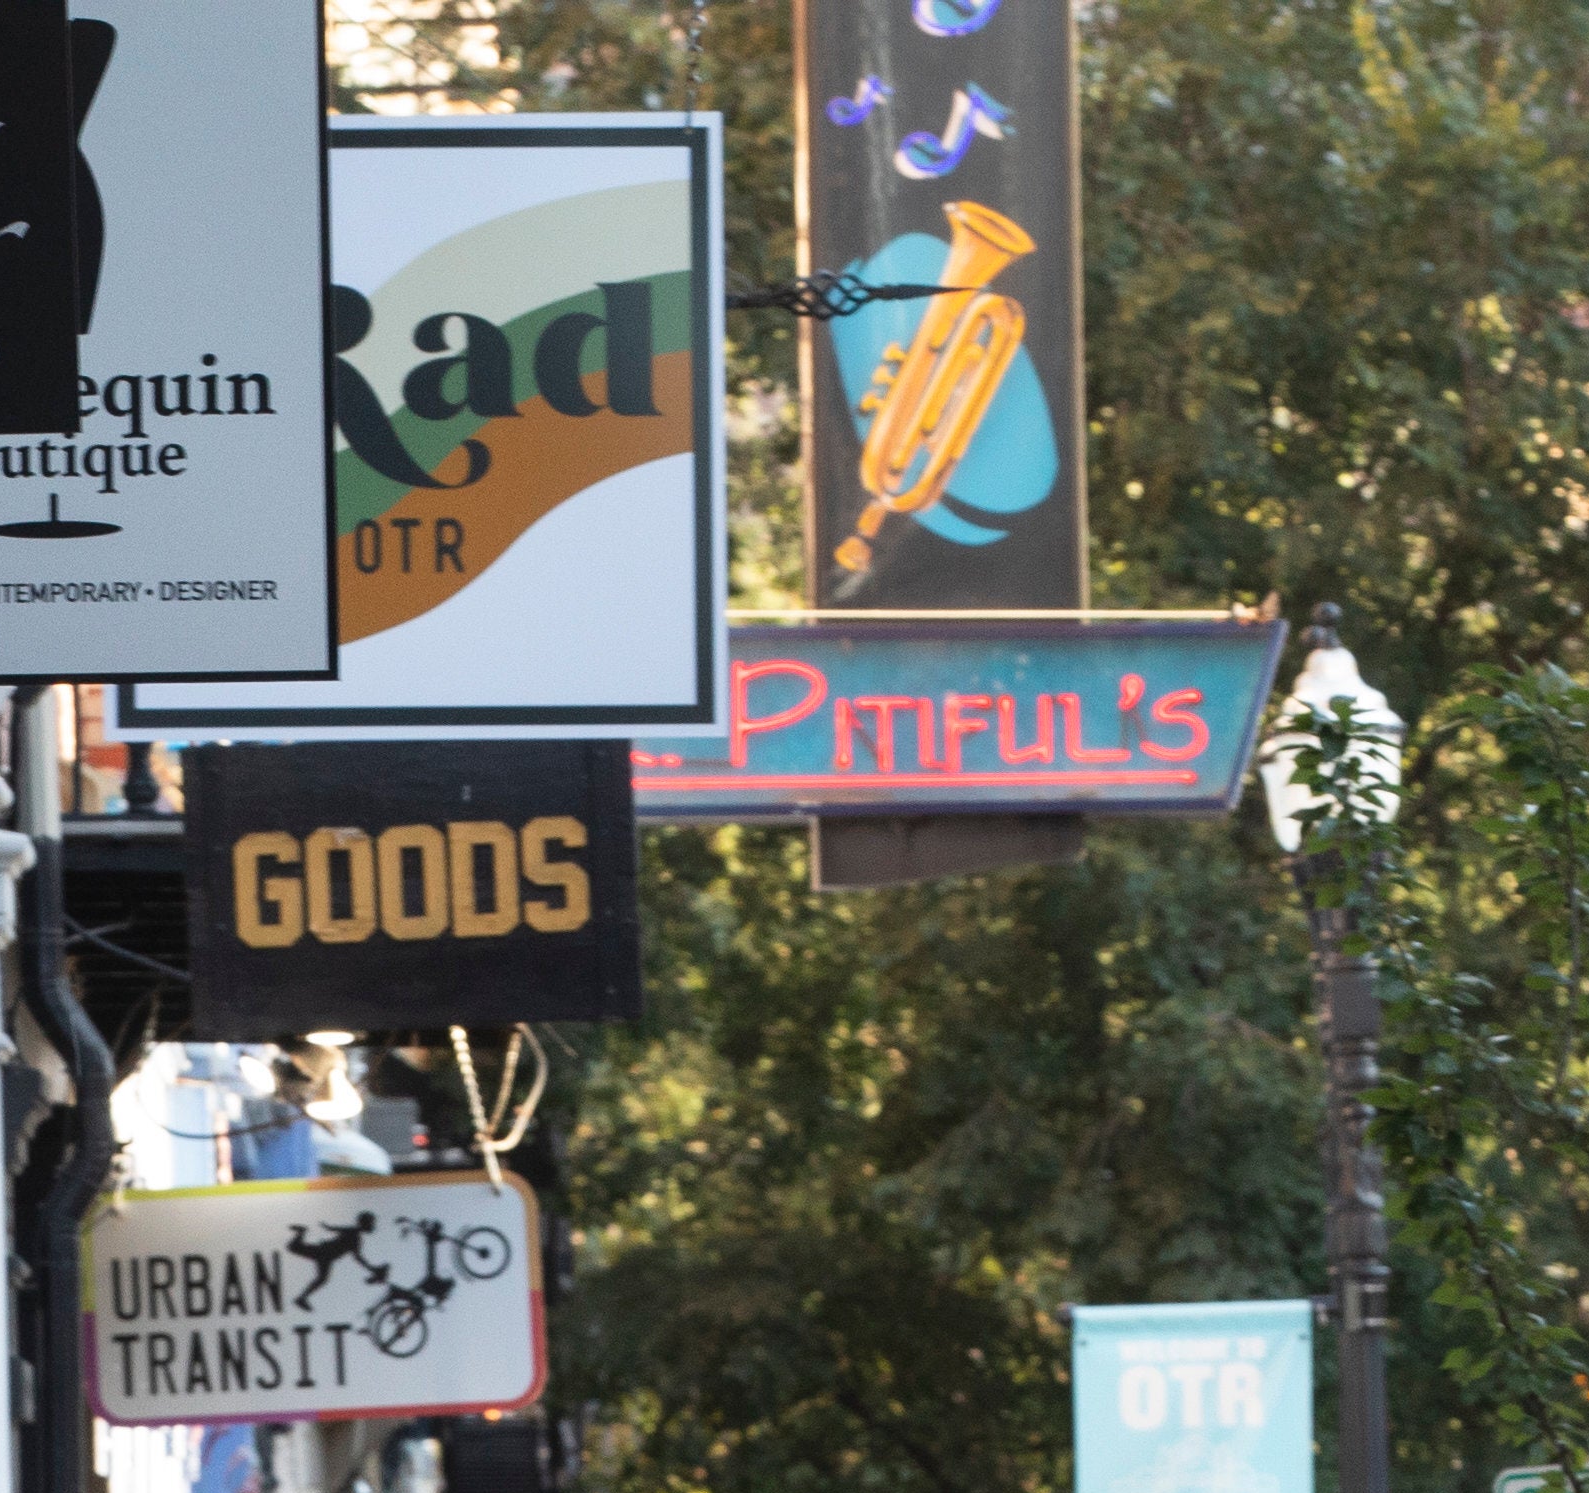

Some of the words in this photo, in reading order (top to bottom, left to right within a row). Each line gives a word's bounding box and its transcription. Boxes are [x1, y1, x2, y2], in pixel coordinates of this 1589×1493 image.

[77, 353, 278, 439] equin
[353, 517, 466, 575] OTR
[158, 579, 279, 602] DESIGNER
[231, 815, 591, 949] GOODS
[111, 1250, 283, 1322] URBAN
[112, 1322, 354, 1398] TRANSIT
